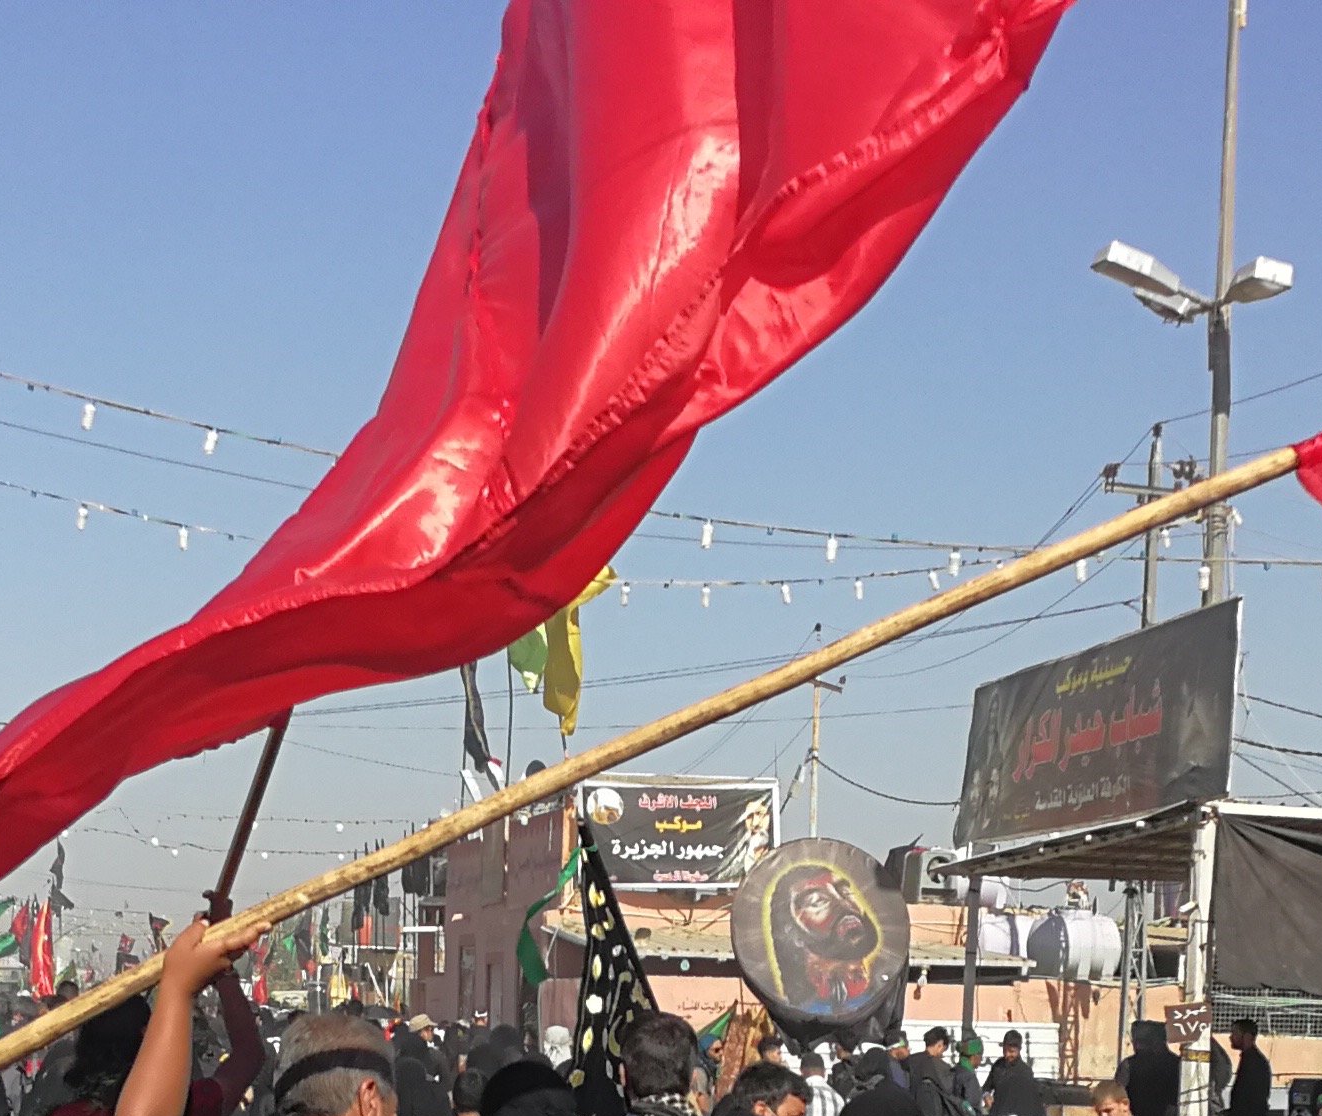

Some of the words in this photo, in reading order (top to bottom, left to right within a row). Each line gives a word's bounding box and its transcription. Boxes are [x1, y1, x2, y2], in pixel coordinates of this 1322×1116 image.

[1109, 677, 1163, 757] شباب
[1012, 707, 1063, 783] الكرار
[1058, 709, 1106, 772] حيدر
[679, 793, 718, 812] النجف
[654, 815, 703, 833] موكب
[611, 838, 674, 861] الجزيرة
[1173, 1005, 1207, 1020] عمود
